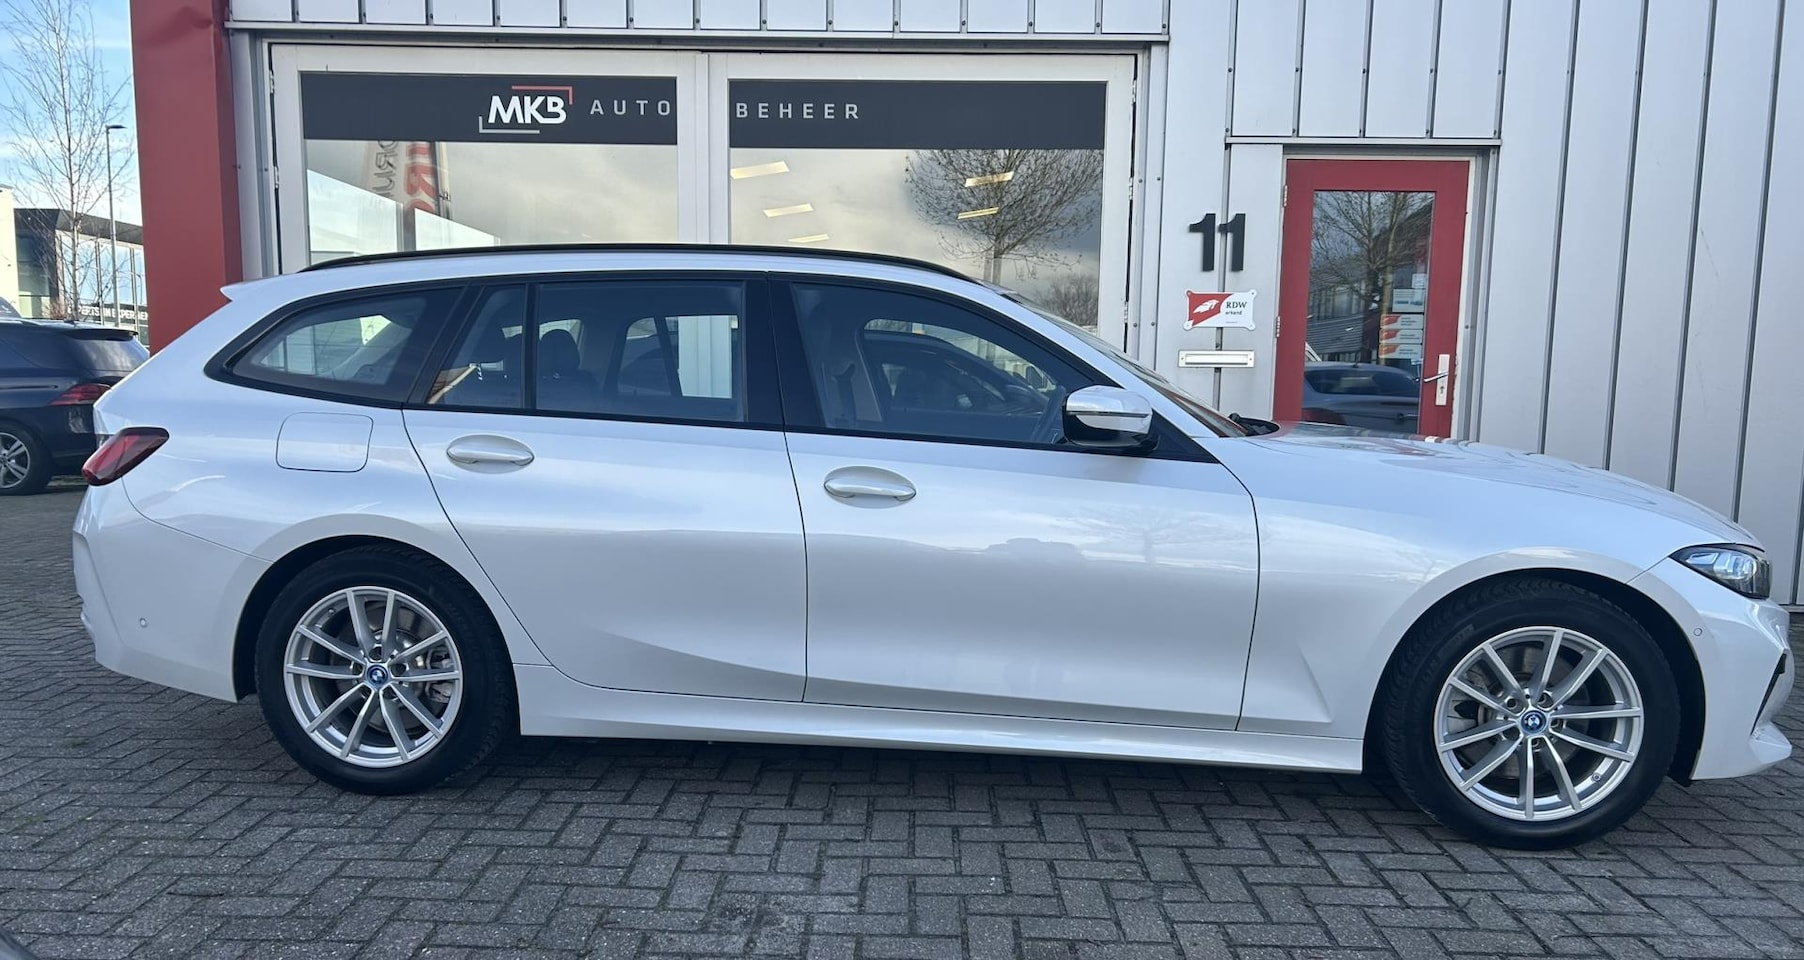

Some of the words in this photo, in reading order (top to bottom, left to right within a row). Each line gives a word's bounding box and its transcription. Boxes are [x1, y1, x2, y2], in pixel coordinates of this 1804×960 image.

[487, 95, 567, 125] MKB
[590, 99, 671, 116] AUTO
[736, 102, 860, 119] BEHEER
[1188, 213, 1247, 272] 11
[68, 304, 99, 316] EPERTS
[1226, 301, 1247, 309] RDW
